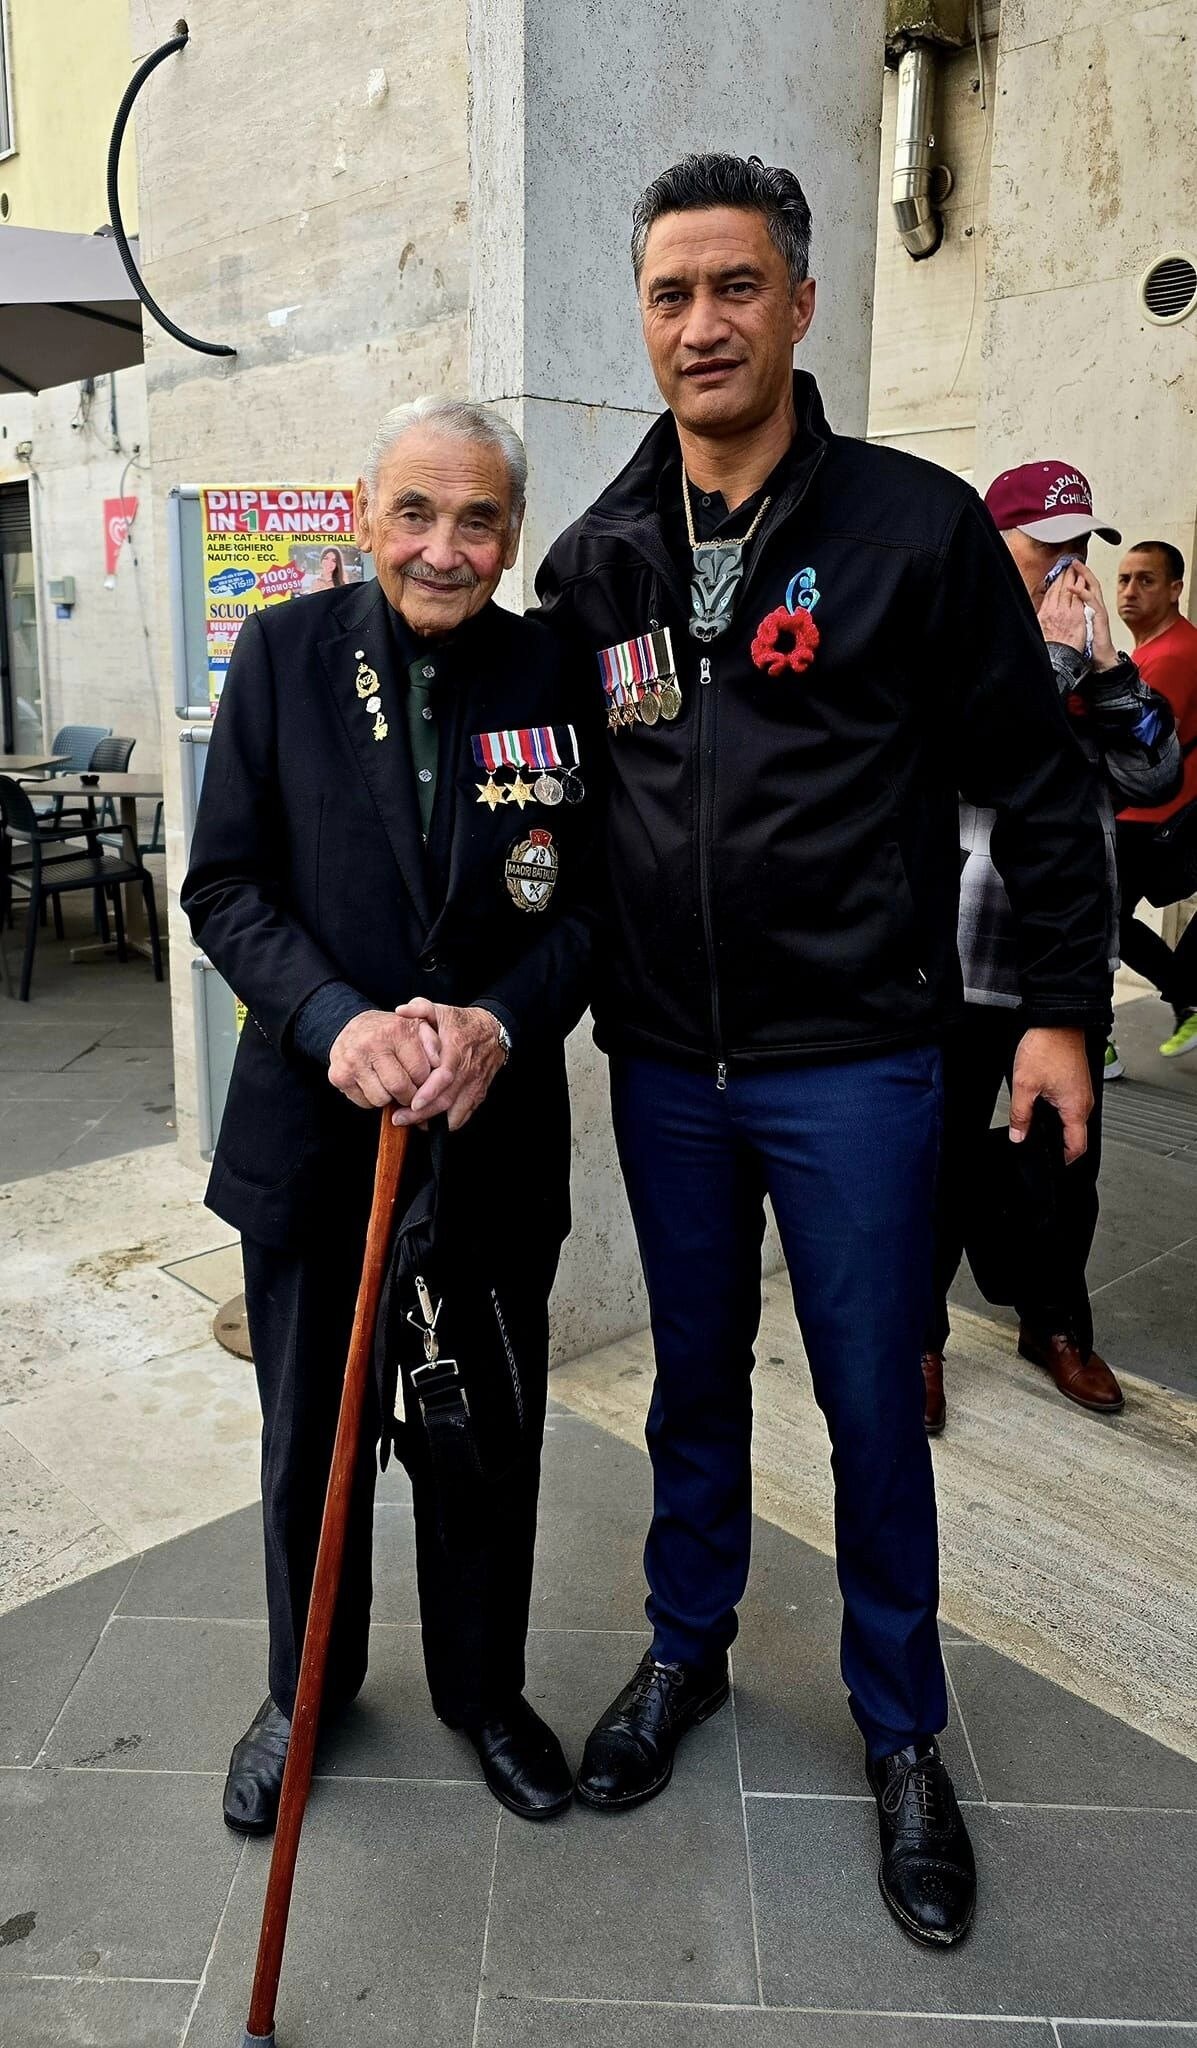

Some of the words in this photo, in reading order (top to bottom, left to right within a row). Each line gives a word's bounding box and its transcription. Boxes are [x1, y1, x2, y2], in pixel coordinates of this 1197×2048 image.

[207, 491, 349, 510] DIPLOMA
[1060, 493, 1088, 505] CHILE
[209, 512, 236, 531] IN
[240, 508, 258, 532] 1
[291, 534, 356, 542] INDUSTRIALE
[207, 544, 273, 552] ALBERGHIERO
[208, 554, 249, 562] NAUTICO
[257, 554, 279, 562] ECC.
[260, 567, 298, 585] 100%
